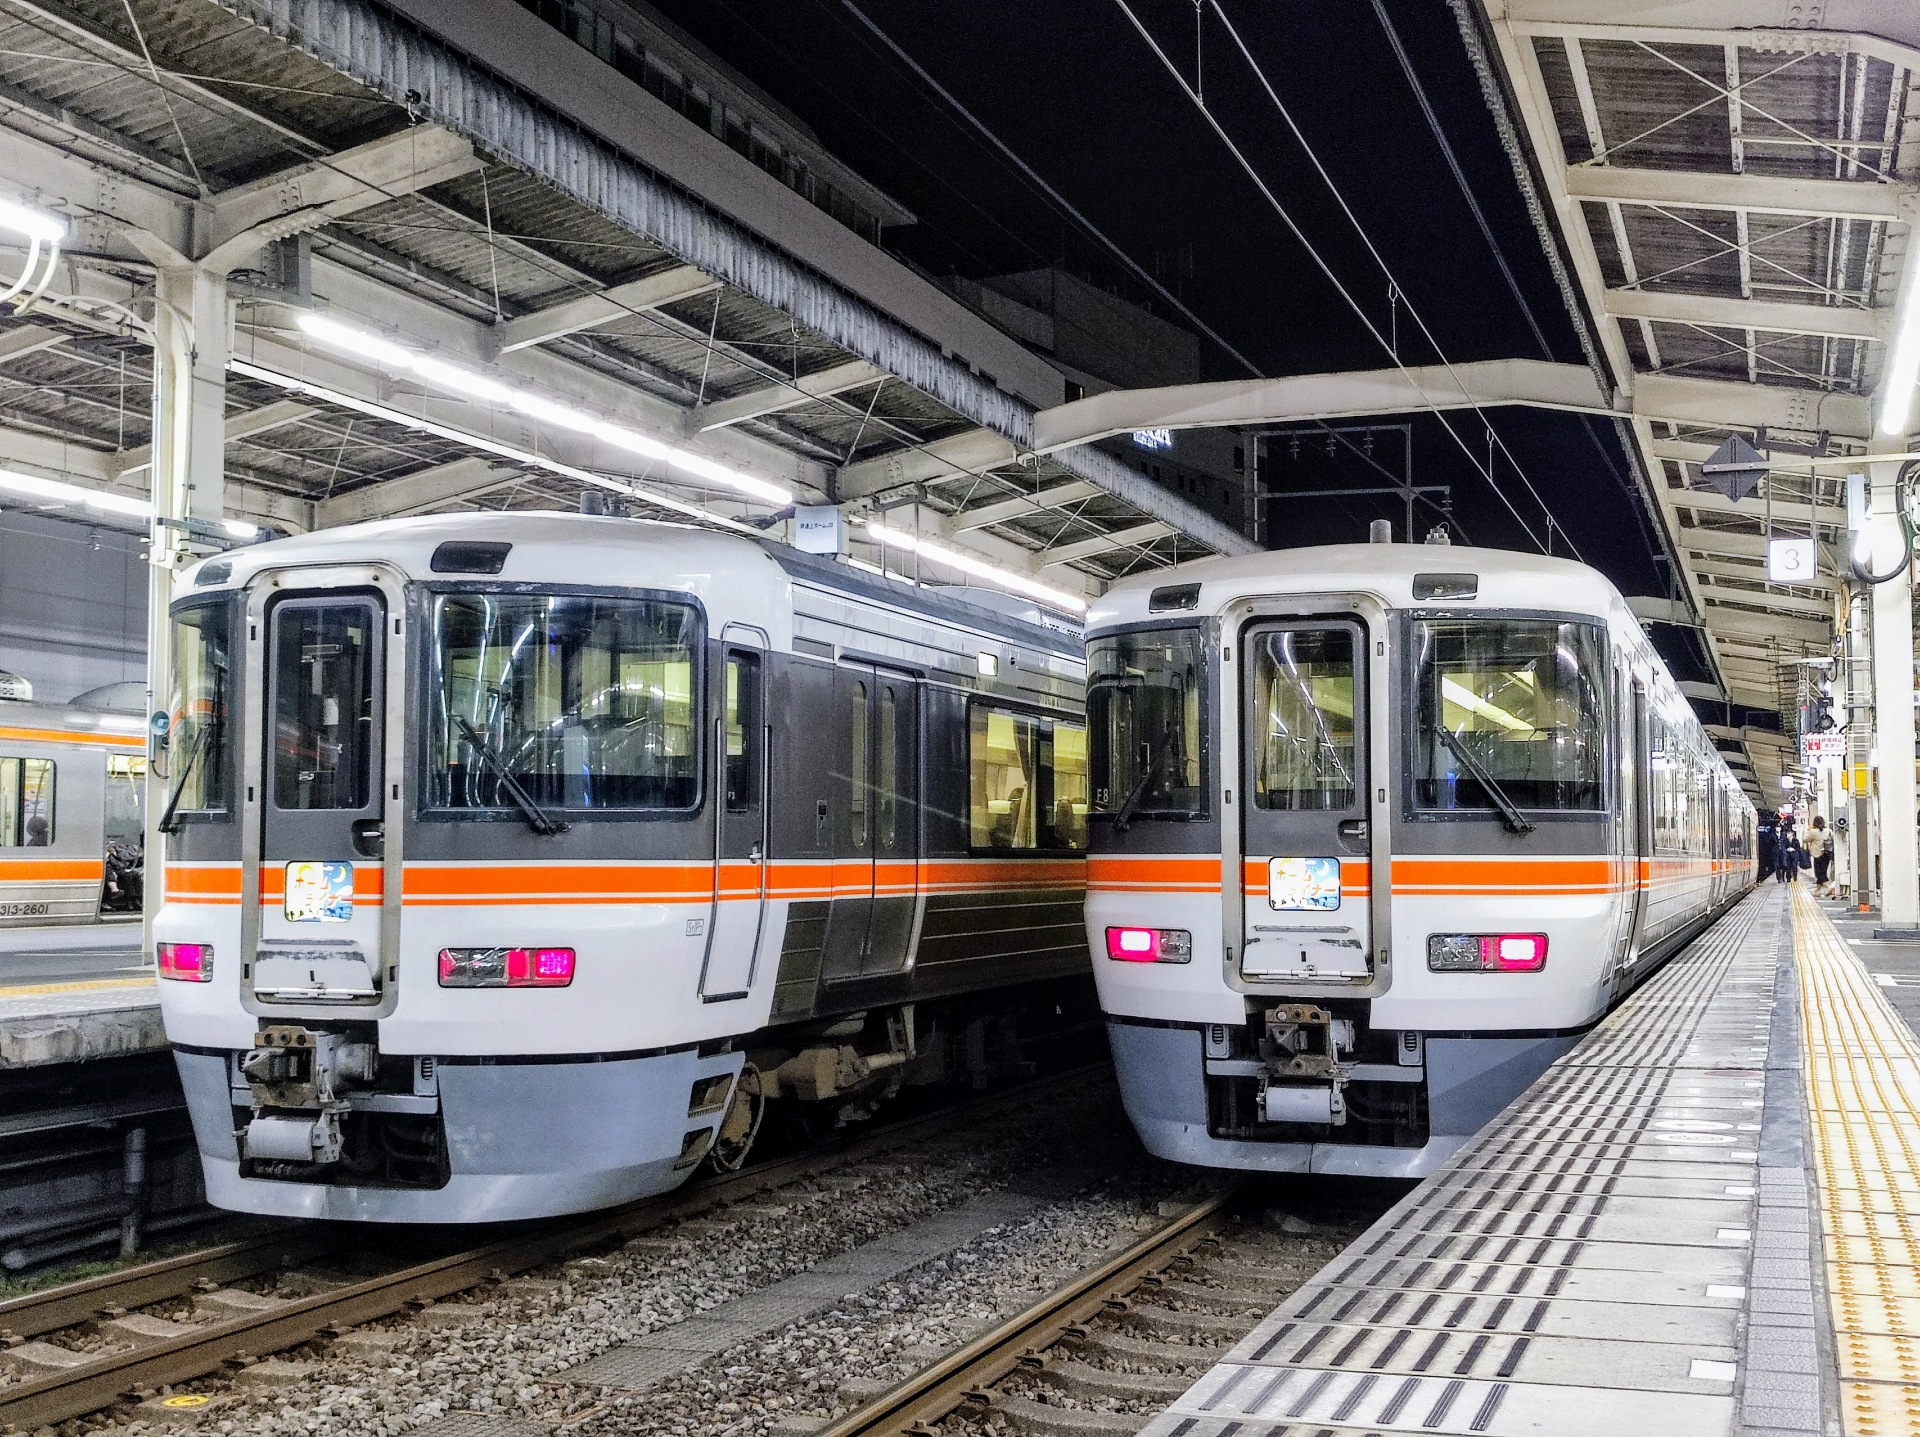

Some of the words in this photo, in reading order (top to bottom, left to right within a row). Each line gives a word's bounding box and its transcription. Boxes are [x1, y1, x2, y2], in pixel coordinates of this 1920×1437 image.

[1784, 548, 1800, 570] 3
[1096, 788, 1109, 803] F8
[0, 904, 49, 916] 313-2601
